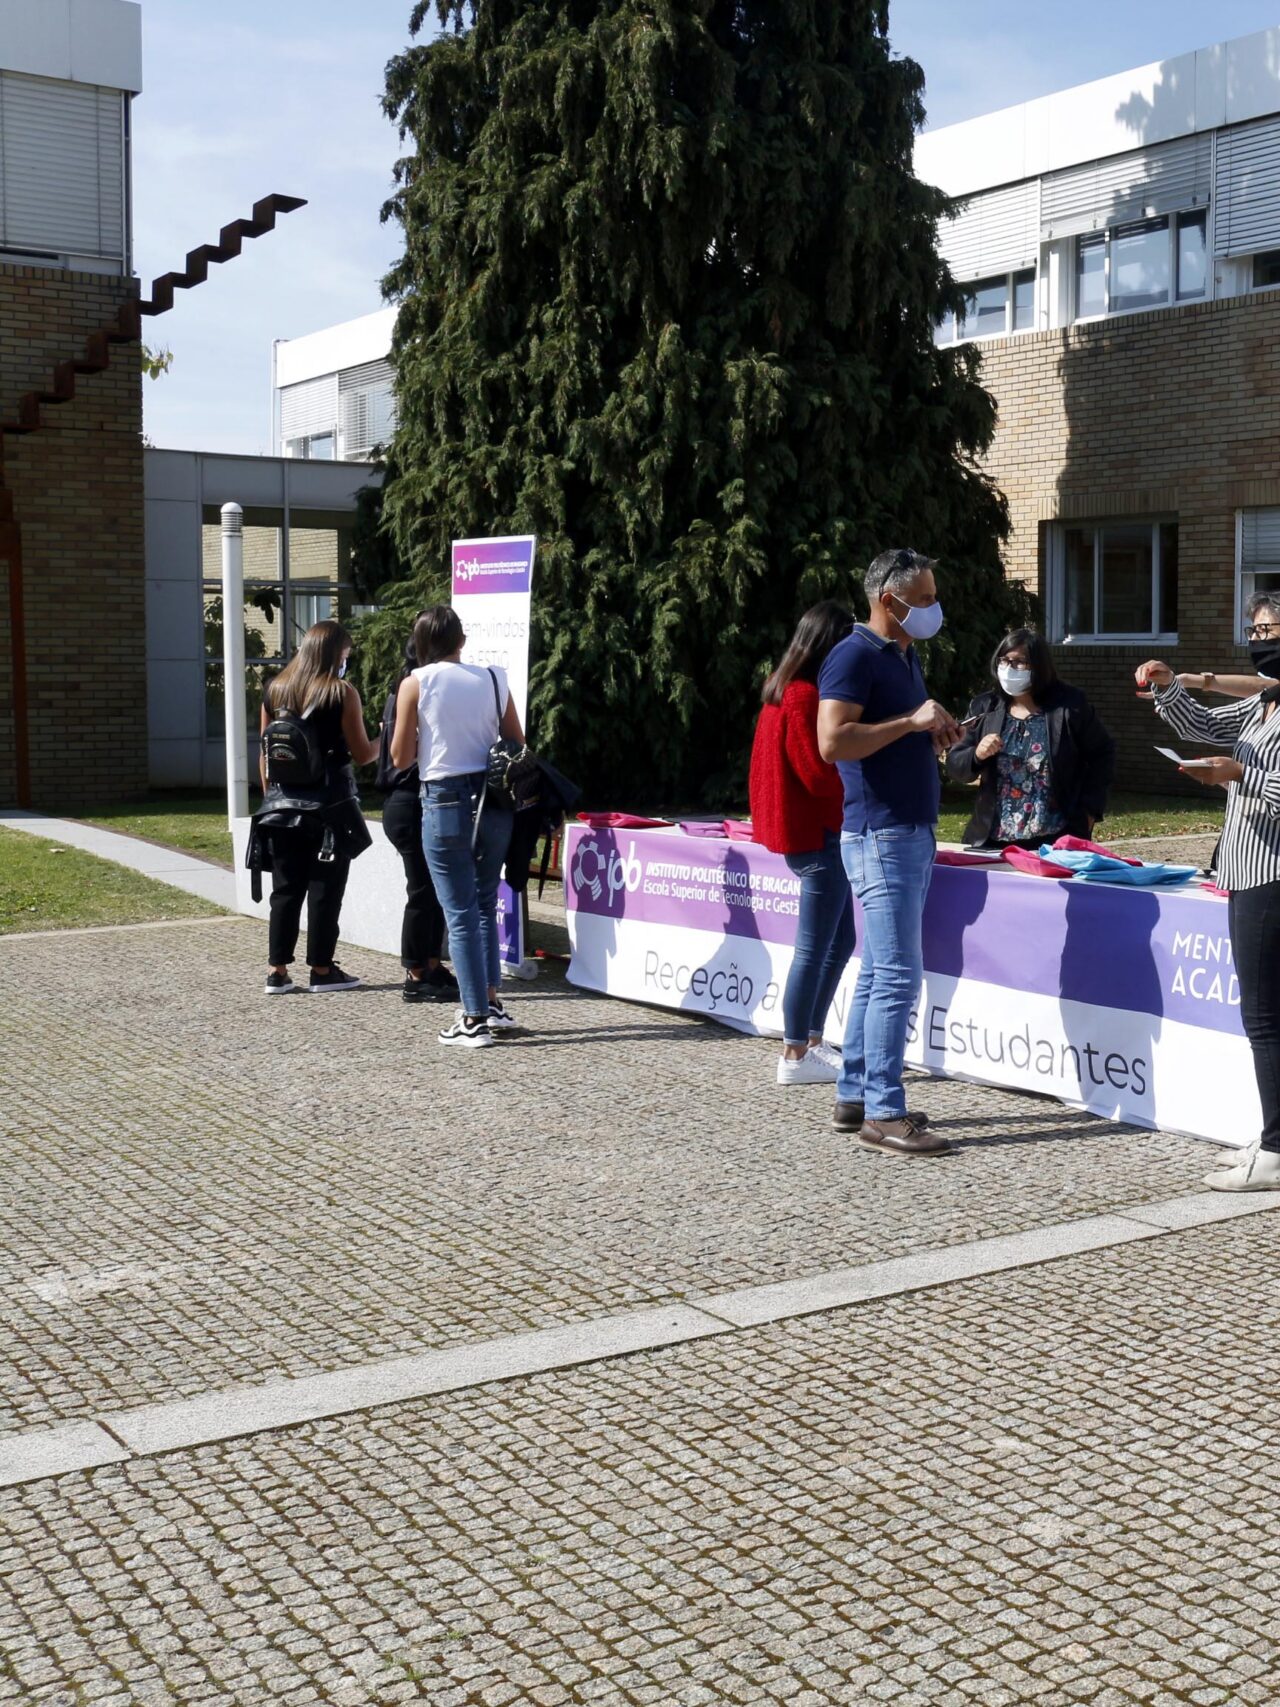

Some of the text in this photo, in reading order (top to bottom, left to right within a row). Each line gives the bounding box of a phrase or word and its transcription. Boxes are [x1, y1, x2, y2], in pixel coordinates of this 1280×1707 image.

[461, 616, 526, 638] em-vindos
[607, 840, 642, 908] ipb
[646, 861, 802, 897] INSTITUTO POLITÉCNICO DE BRAGAN
[644, 880, 800, 916] Escola Superior de Tecnologia e Gestã
[644, 950, 754, 1010] Receção
[929, 1005, 1146, 1096] Estudantes
